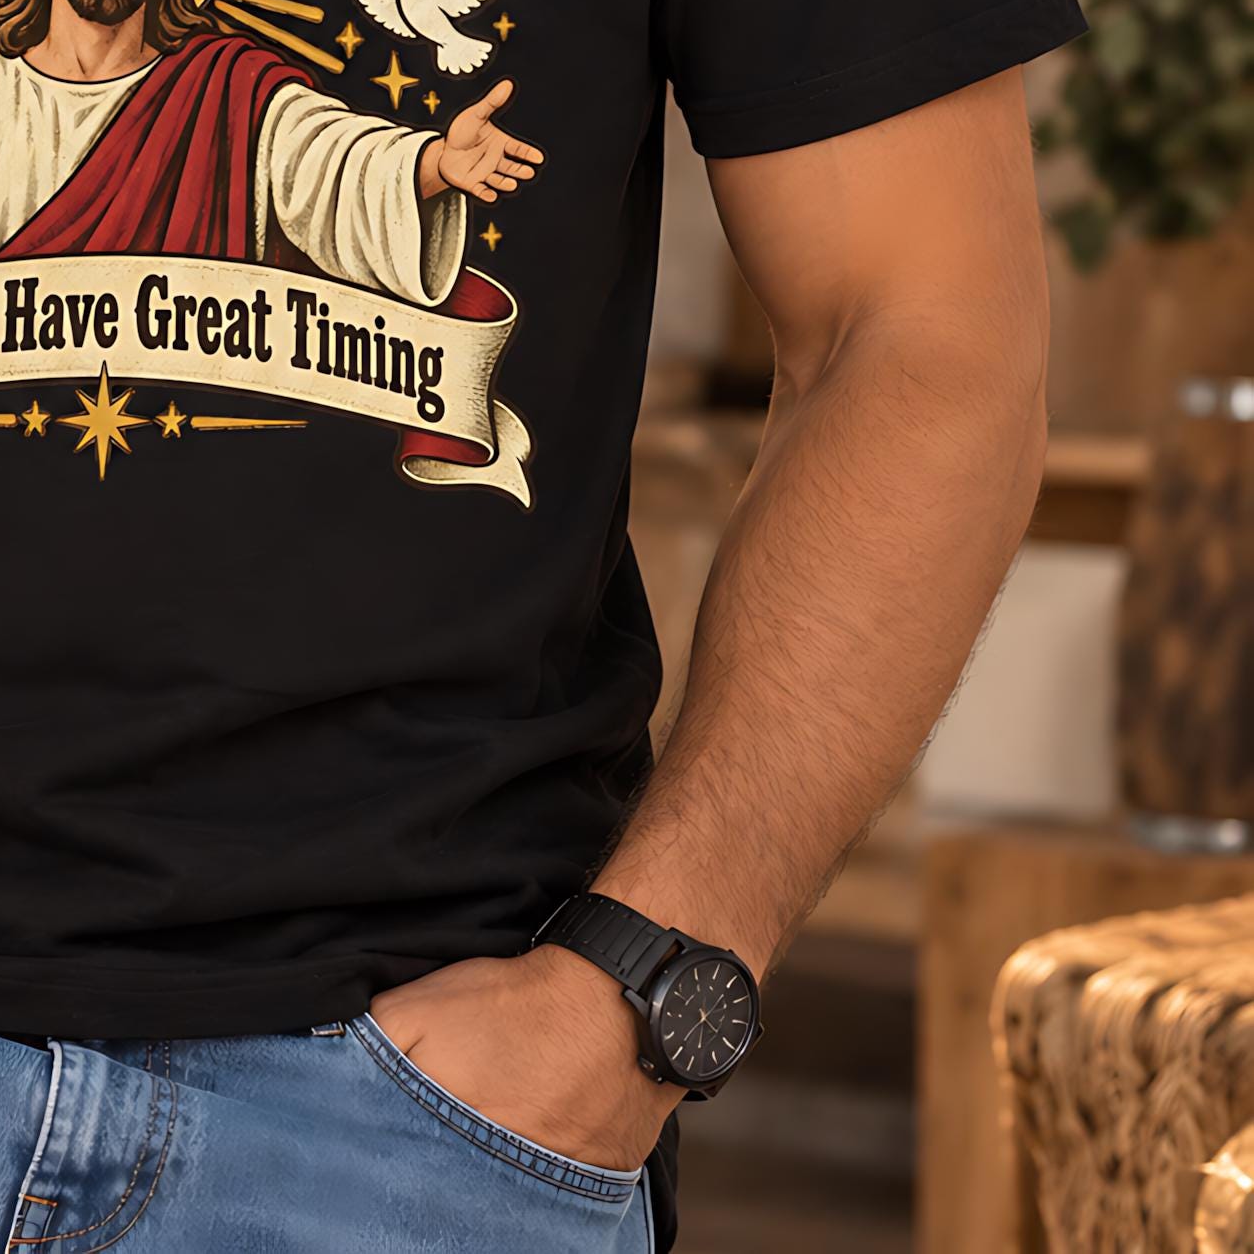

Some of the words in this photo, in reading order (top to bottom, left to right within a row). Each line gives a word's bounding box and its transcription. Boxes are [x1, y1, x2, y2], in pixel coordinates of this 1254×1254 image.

[1, 277, 119, 352] Have
[135, 274, 273, 364] Great
[287, 287, 446, 423] Timing
